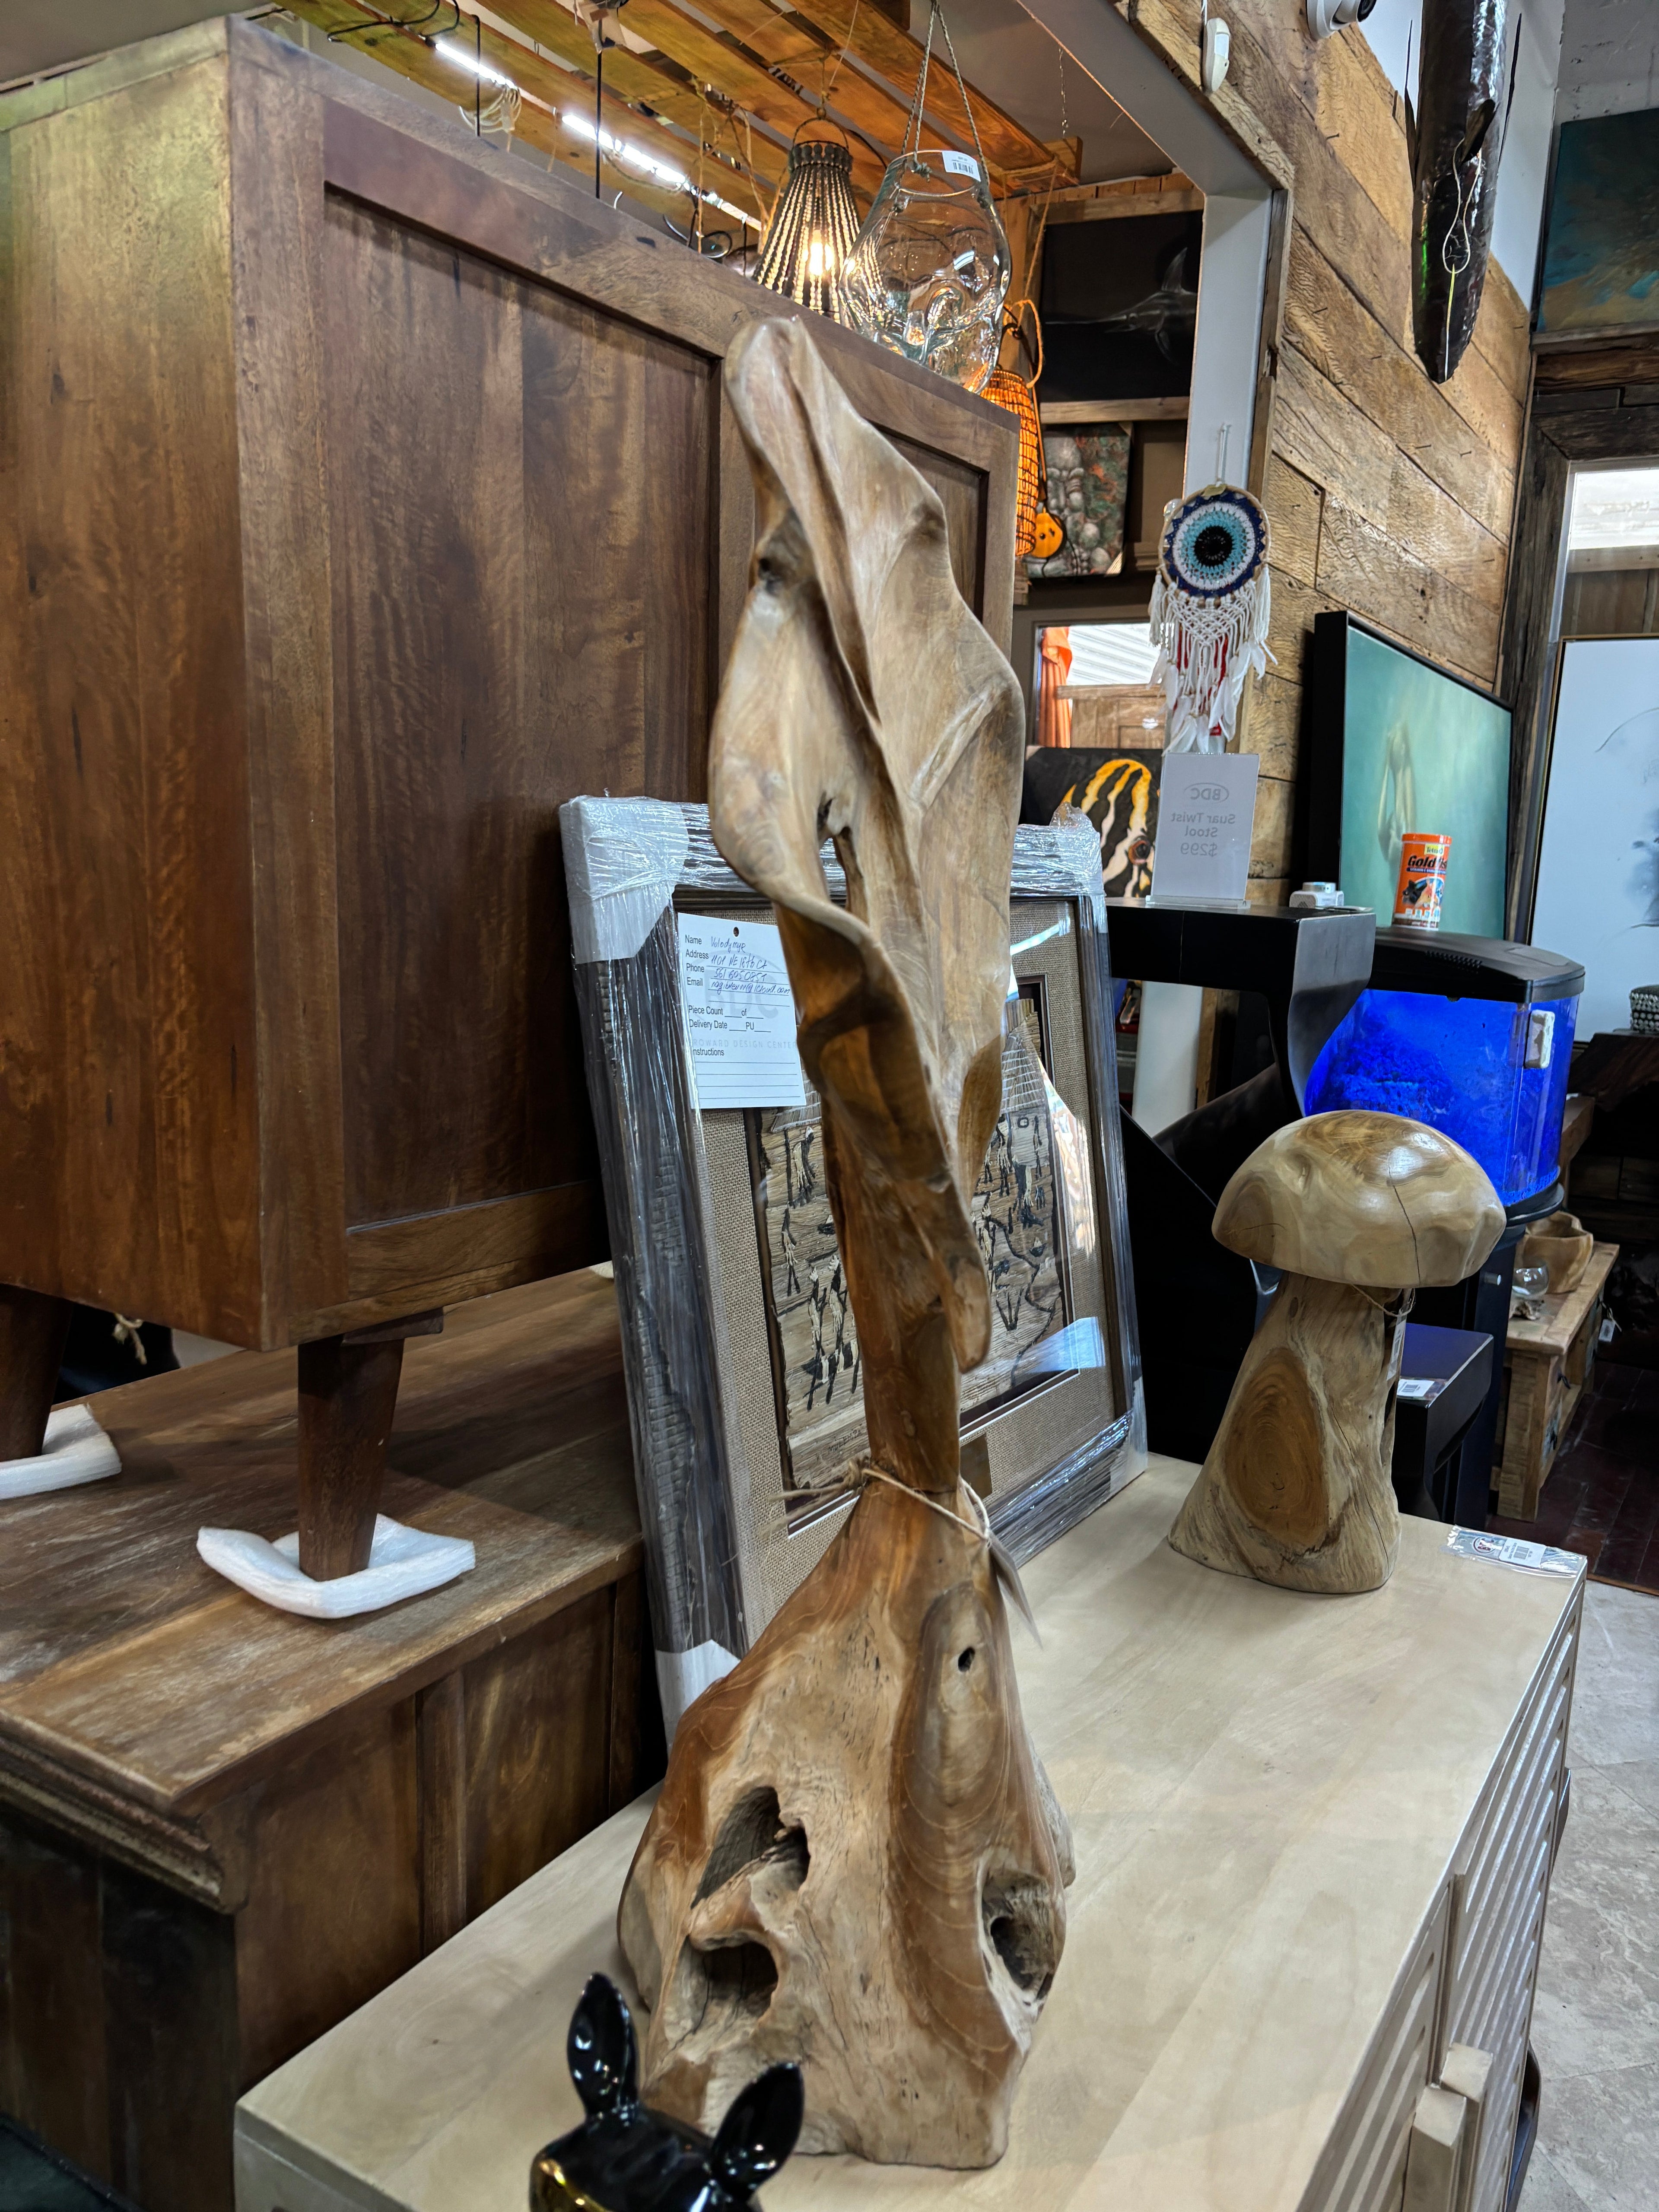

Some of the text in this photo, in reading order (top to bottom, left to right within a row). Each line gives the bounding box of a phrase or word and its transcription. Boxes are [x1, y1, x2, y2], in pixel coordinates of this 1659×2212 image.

[685, 934, 702, 944] Name
[686, 949, 709, 959] Address
[728, 954, 738, 966] NE
[686, 963, 705, 973] Phone
[687, 977, 703, 986] Email
[688, 1005, 705, 1014] Piece
[706, 1006, 723, 1015] Count
[689, 1019, 712, 1030] Delivery
[714, 1020, 728, 1029] Date
[693, 1039, 729, 1047] ROWARD
[693, 1047, 725, 1056] nstructions
